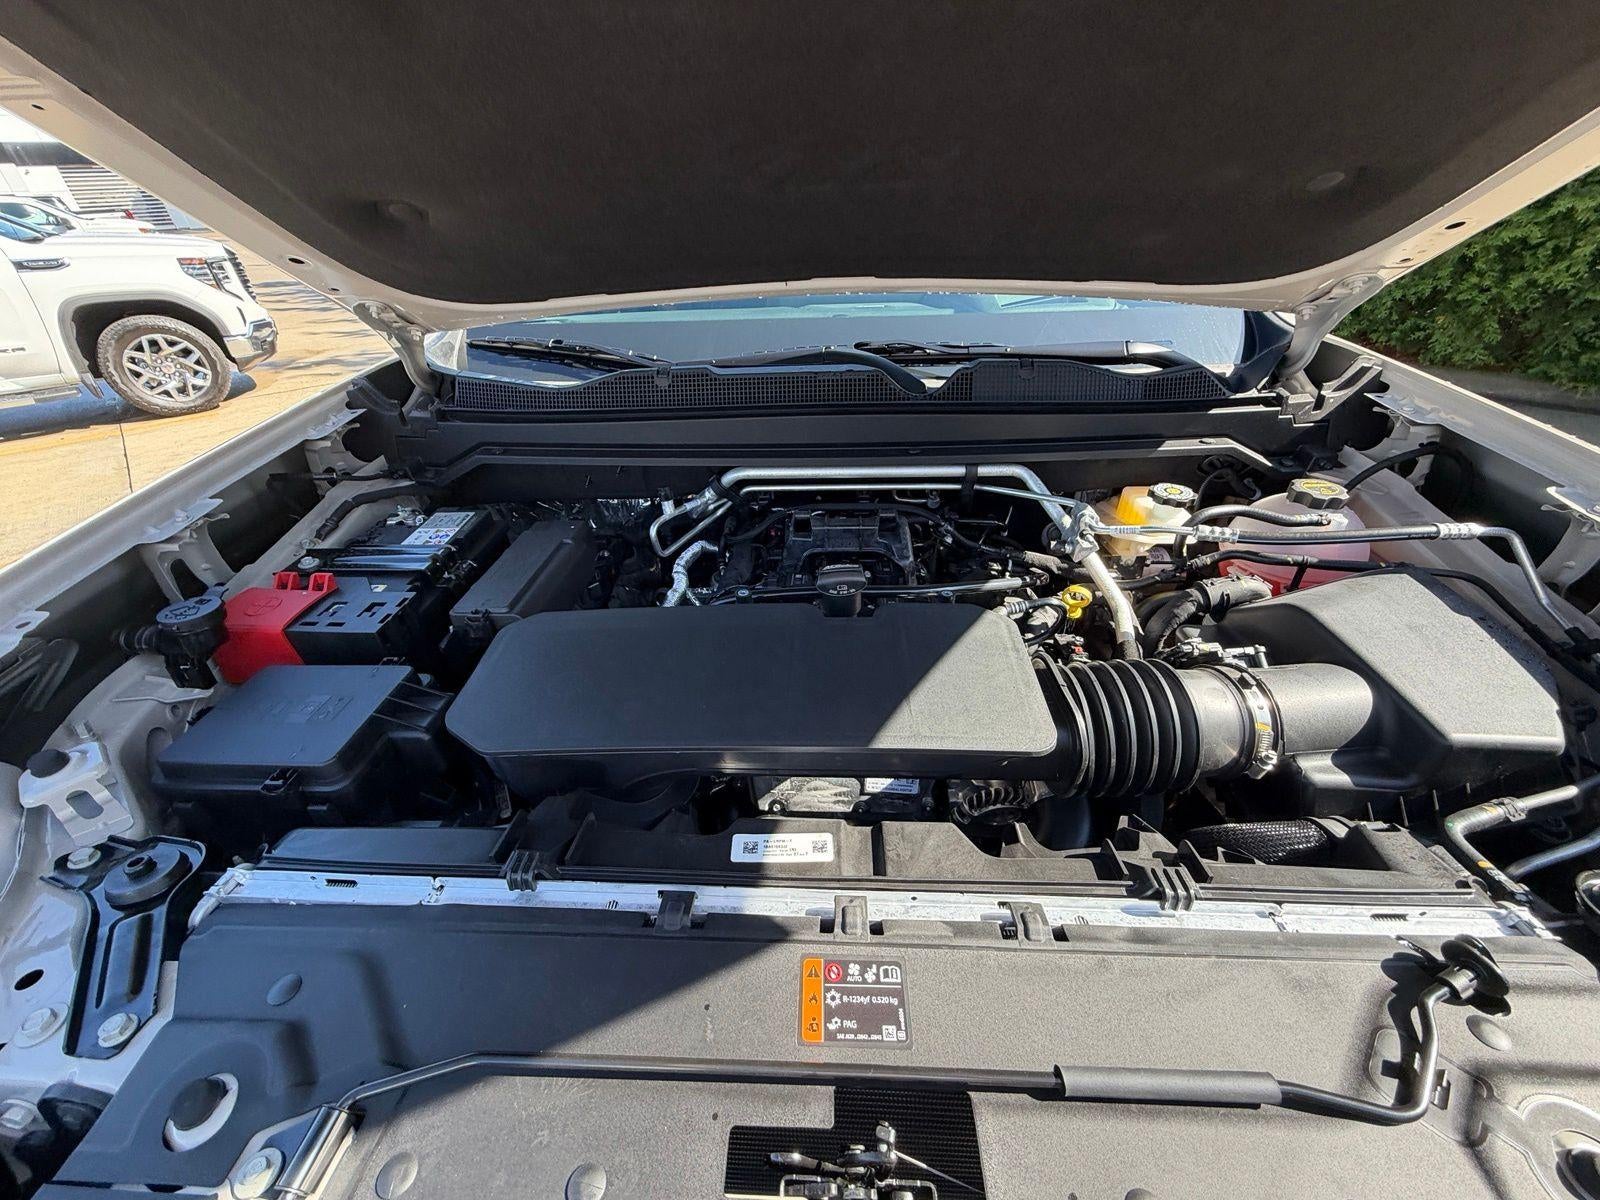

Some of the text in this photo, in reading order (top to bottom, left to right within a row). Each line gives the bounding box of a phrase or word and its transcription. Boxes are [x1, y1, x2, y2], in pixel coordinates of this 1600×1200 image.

[842, 995, 898, 1005] R-1234yf 0.520 kg
[843, 1020, 857, 1028] PAG
